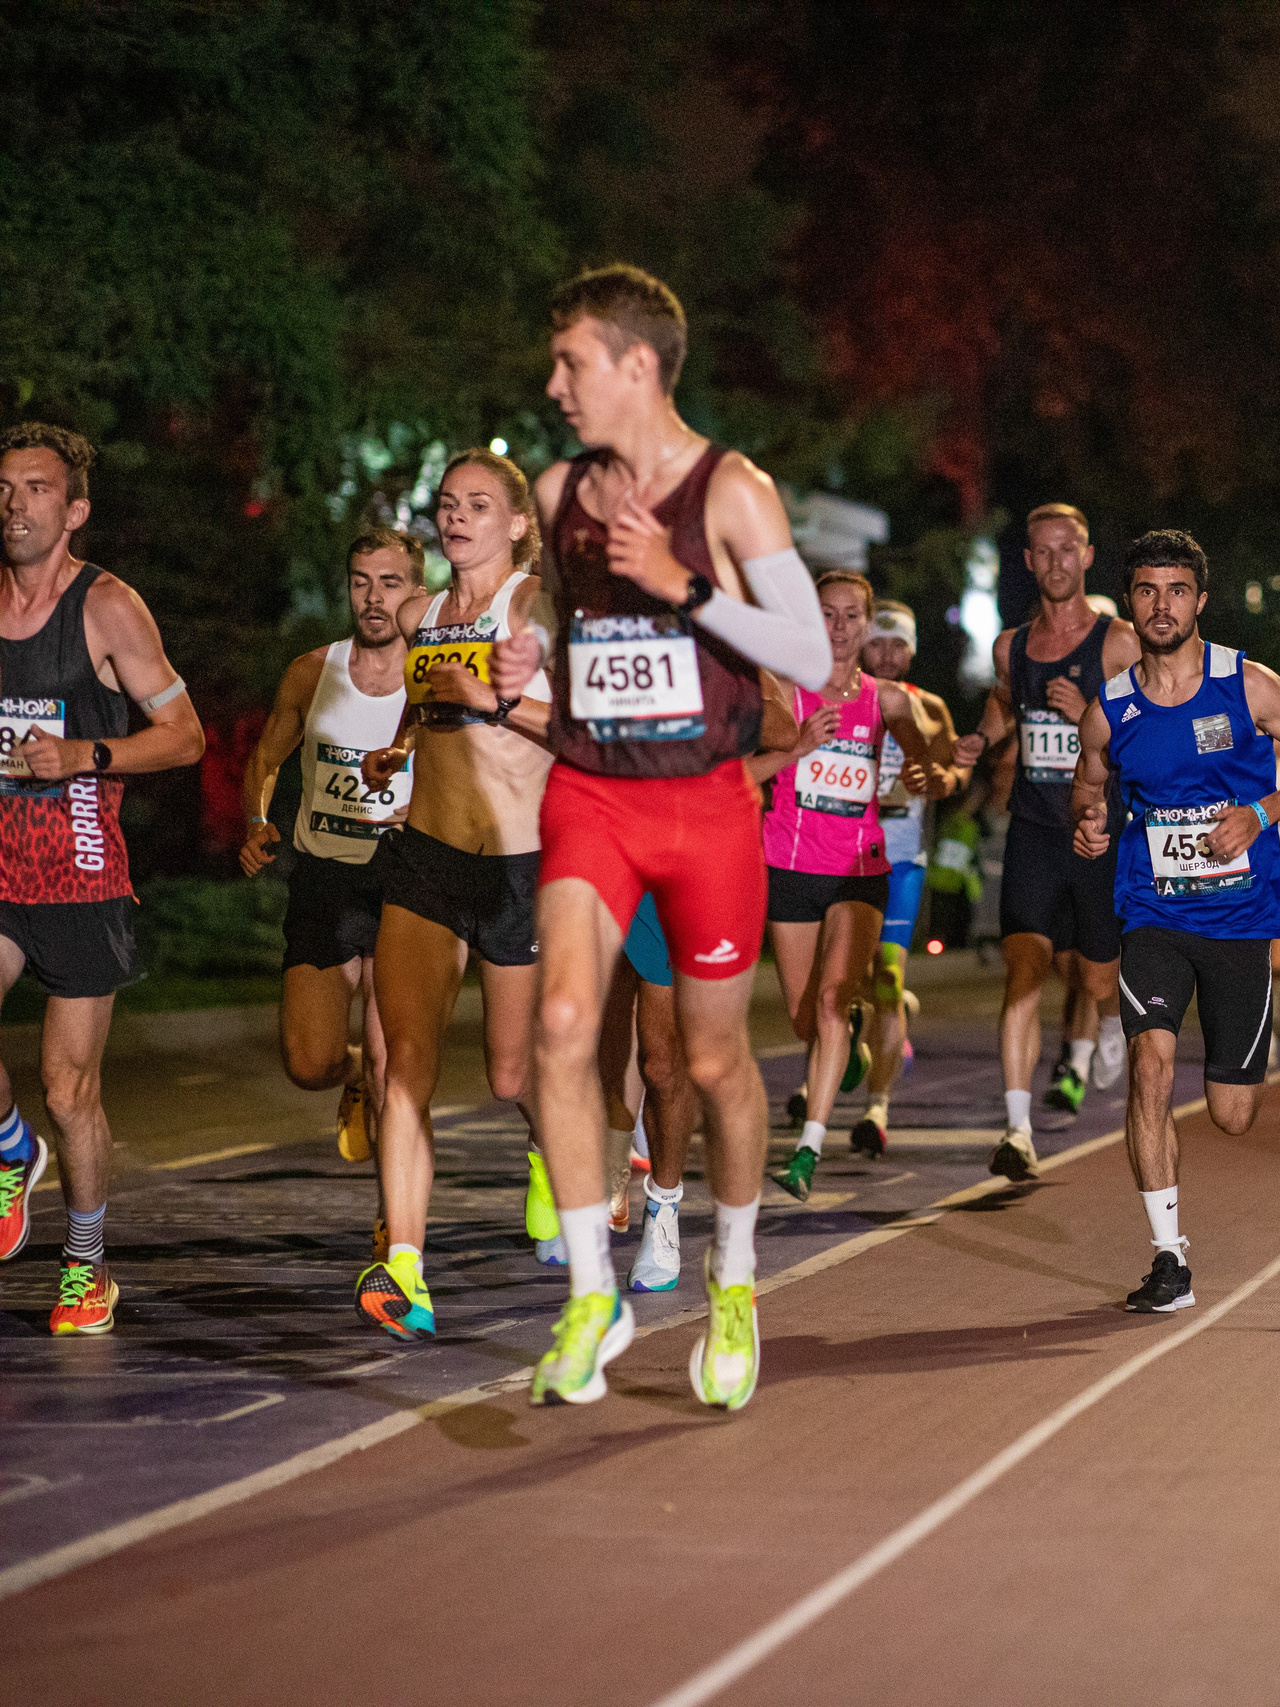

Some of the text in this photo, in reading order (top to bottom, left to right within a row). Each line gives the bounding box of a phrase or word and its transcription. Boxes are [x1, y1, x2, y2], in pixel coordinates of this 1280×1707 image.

[422, 622, 490, 642] НОЧНО
[586, 653, 674, 692] 4581
[1121, 709, 1142, 723] adidas
[1028, 731, 1080, 754] 1118
[810, 760, 868, 790] 9669
[341, 803, 373, 814] ДЕНИС
[1162, 832, 1214, 860] 453
[1179, 862, 1220, 872] ШЕРЗОД
